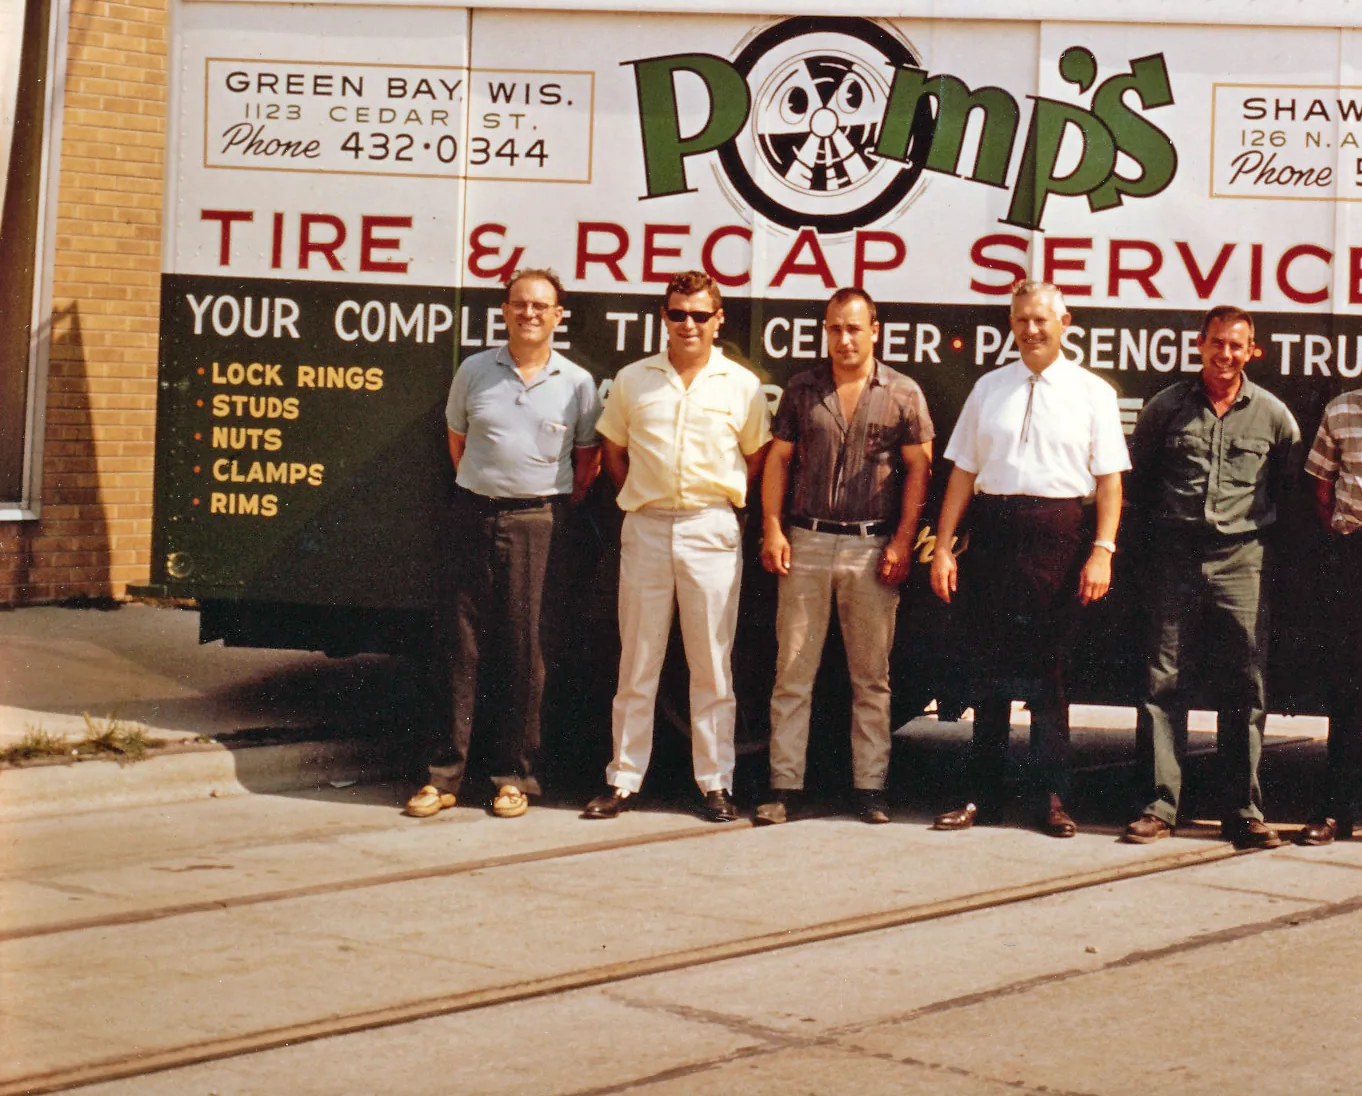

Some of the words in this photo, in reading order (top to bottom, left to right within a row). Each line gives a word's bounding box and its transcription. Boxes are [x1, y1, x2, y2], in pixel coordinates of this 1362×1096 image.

[225, 71, 364, 98] GREEN
[387, 78, 463, 102] BAY,
[488, 82, 573, 106] WIS.
[244, 103, 302, 120] 1123
[329, 106, 449, 127] CEDAR
[482, 112, 538, 130] ST.
[221, 122, 321, 159] Phone
[1241, 129, 1286, 147] 126
[1229, 150, 1332, 187] Phone
[201, 209, 413, 274] TIRE
[467, 223, 526, 282] &
[575, 221, 907, 288] RECAP
[186, 294, 300, 339] YOUR
[763, 316, 941, 363] CEER
[975, 325, 1202, 373] PASENGE
[212, 362, 283, 386] LOCK
[298, 366, 384, 391] RINGS
[212, 395, 300, 420] STUDS
[212, 427, 283, 451] NUTS
[212, 459, 324, 486] CLAMPS
[210, 492, 279, 516] RIMS
